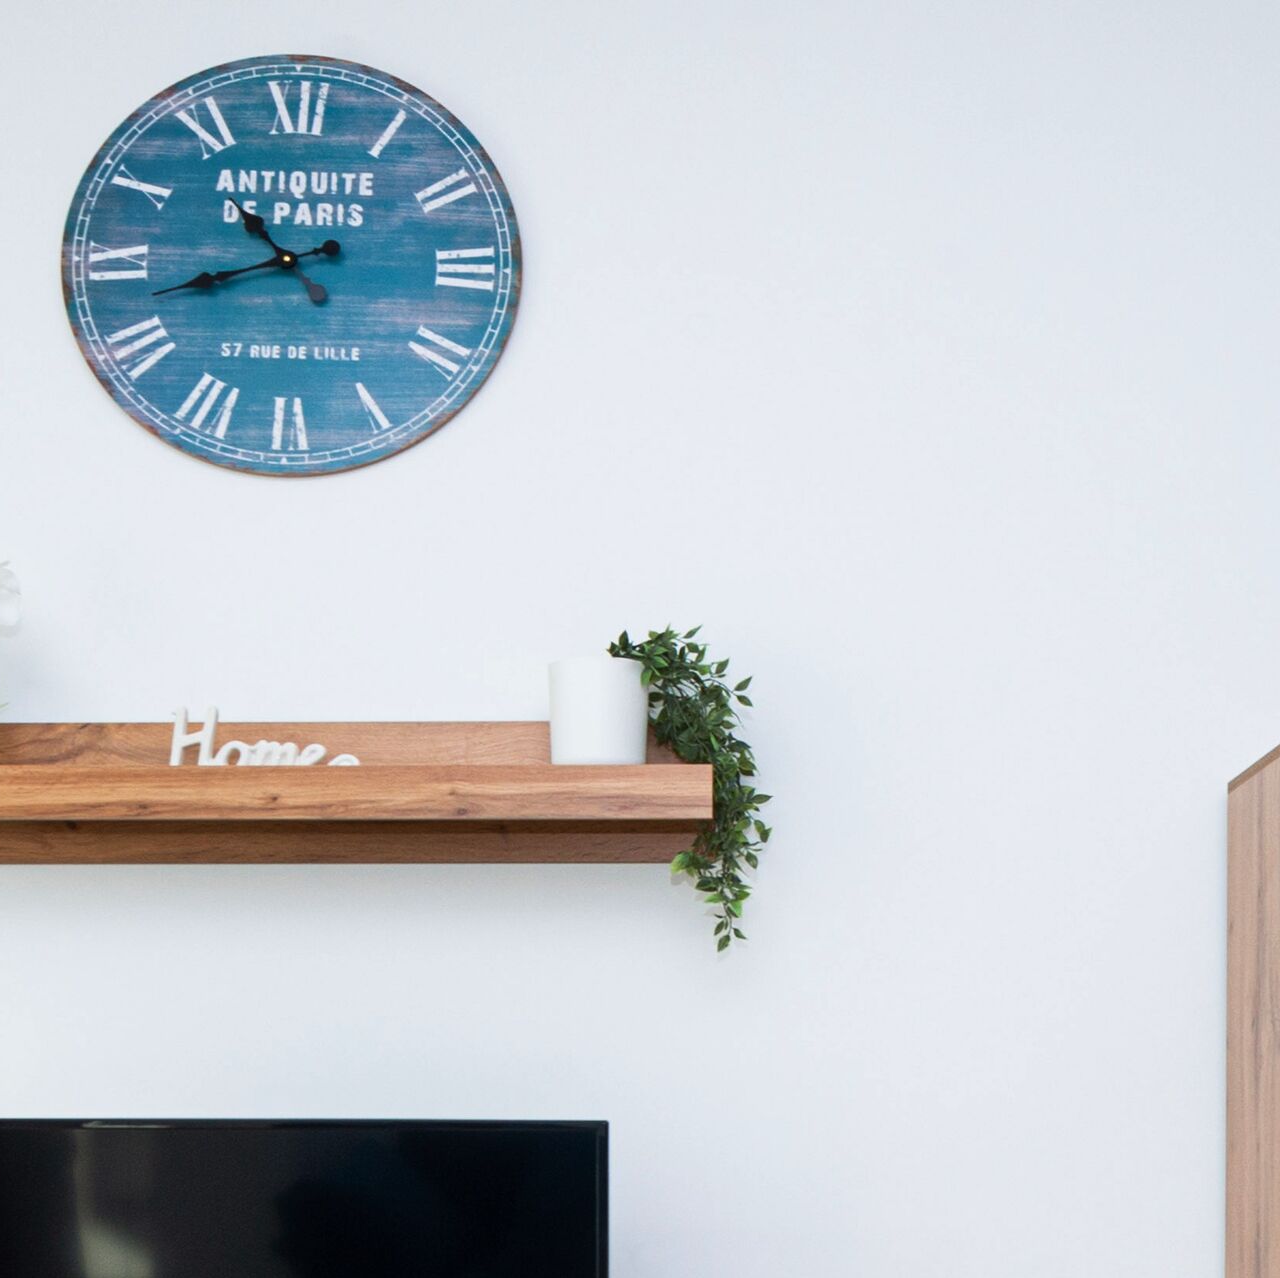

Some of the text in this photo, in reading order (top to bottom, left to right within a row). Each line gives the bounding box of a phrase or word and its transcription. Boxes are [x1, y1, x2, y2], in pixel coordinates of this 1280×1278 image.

[268, 81, 329, 136] XII
[216, 170, 374, 197] ANTIQUITE
[273, 202, 365, 226] PARIS
[221, 344, 360, 361] 57 RUE DE LILLE
